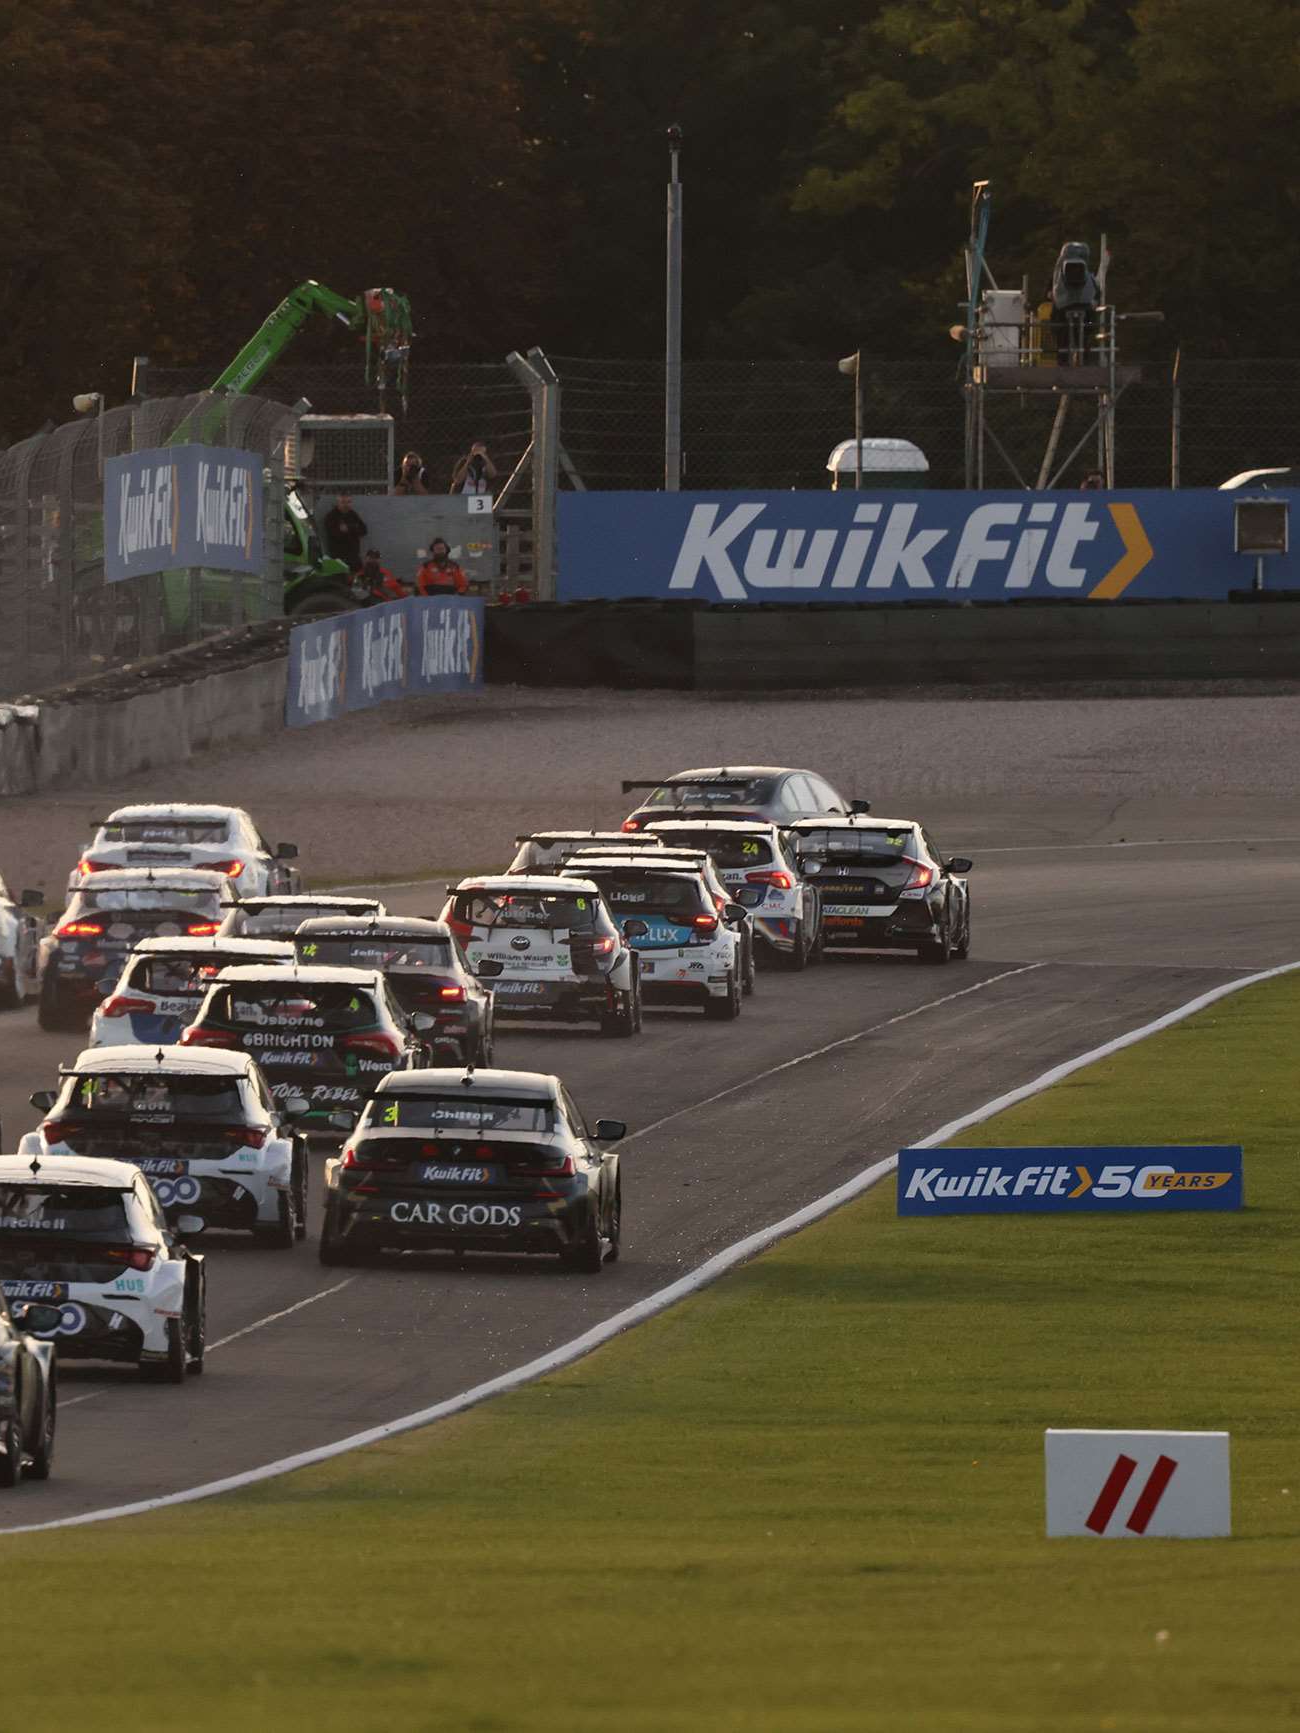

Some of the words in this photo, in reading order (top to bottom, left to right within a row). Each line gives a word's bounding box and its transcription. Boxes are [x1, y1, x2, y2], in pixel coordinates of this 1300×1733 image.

[476, 499, 485, 511] 3
[741, 841, 759, 856] 24
[576, 897, 586, 912] 6
[258, 1014, 325, 1028] Osborne
[311, 1084, 361, 1102] REBEL
[383, 1104, 400, 1123] 3
[1149, 1174, 1217, 1189] YEARS
[390, 1201, 445, 1224] CAR
[448, 1203, 522, 1227] GODS
